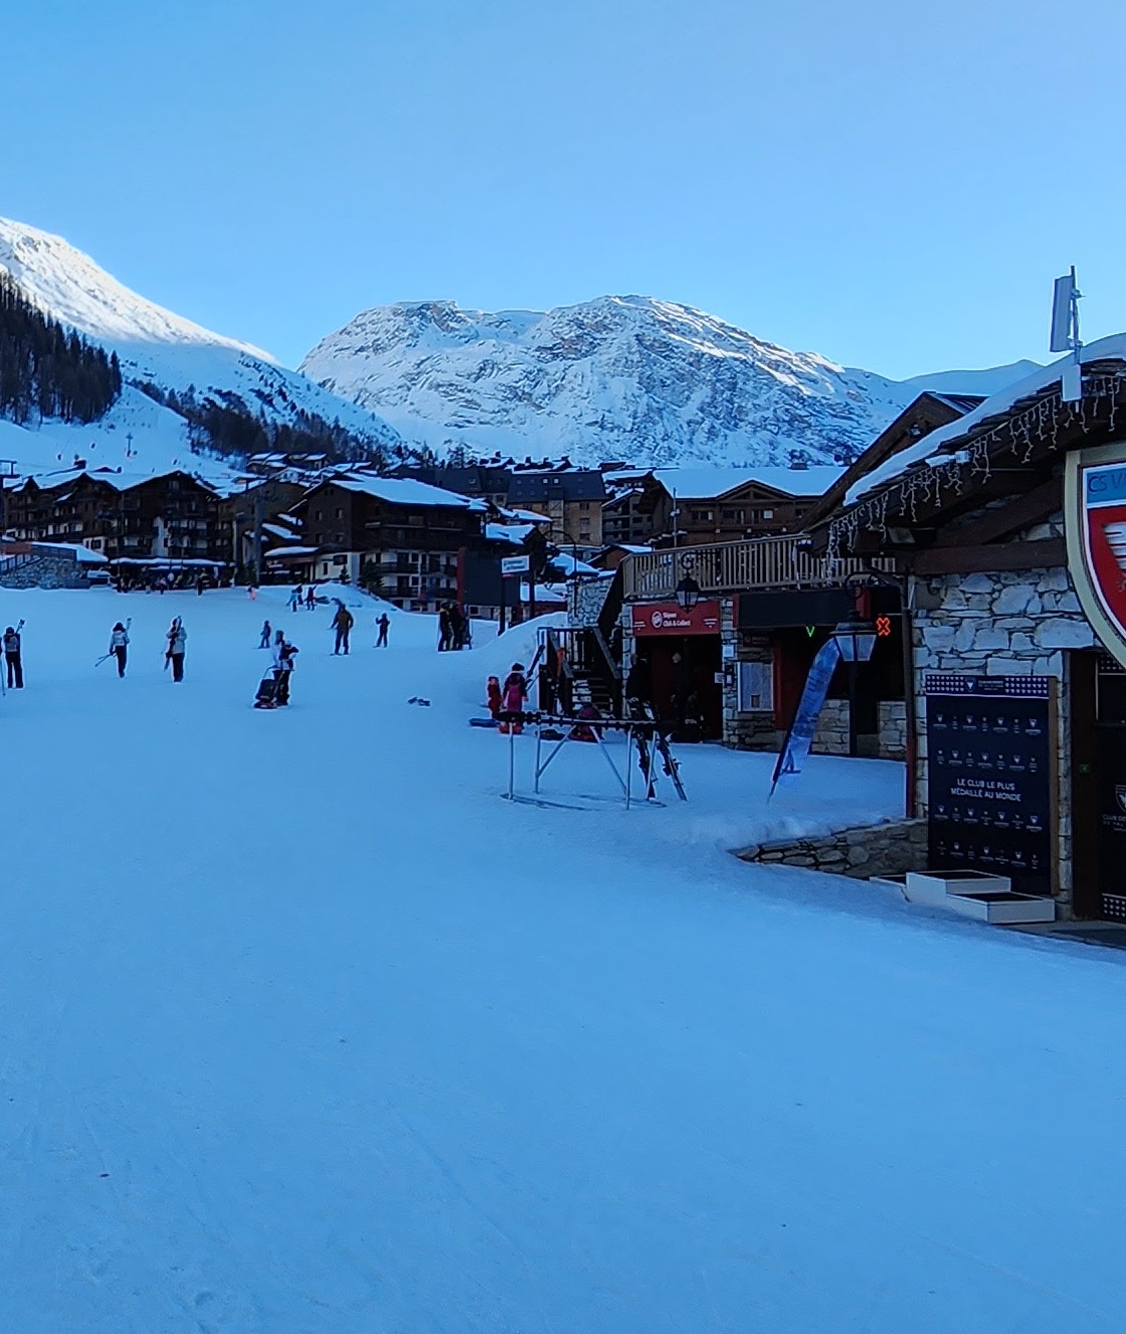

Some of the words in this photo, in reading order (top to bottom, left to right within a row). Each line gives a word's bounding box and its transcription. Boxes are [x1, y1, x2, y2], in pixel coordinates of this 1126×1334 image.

[1087, 474, 1107, 493] CS
[1110, 472, 1126, 490] V
[956, 778, 966, 787] LE
[967, 779, 985, 788] CLUB
[986, 780, 996, 789] LE
[996, 781, 1015, 791] PLUS
[984, 790, 994, 799] AU
[995, 791, 1022, 802] MONDE
